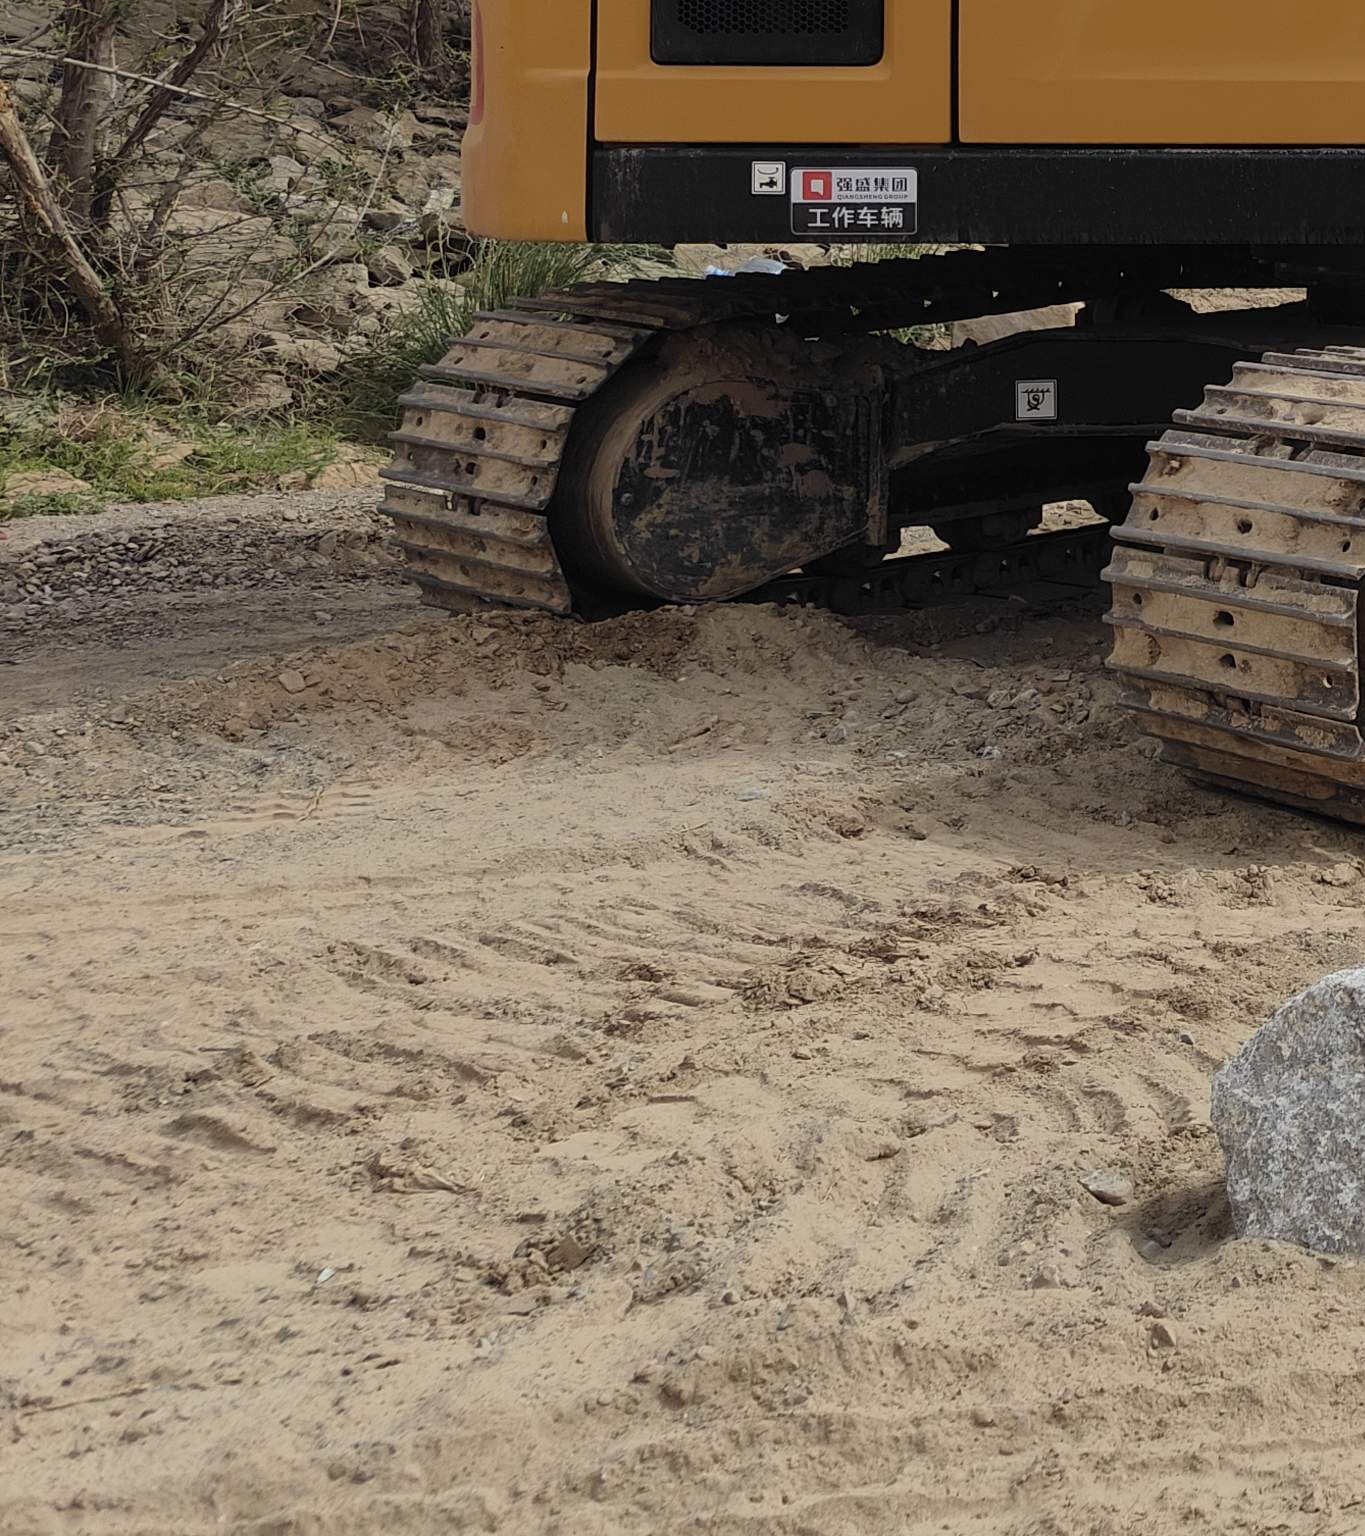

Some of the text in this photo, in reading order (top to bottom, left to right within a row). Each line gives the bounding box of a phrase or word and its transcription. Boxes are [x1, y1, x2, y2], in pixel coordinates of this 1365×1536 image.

[836, 177, 908, 192] 强盛集团
[807, 206, 903, 228] 工作车辆
